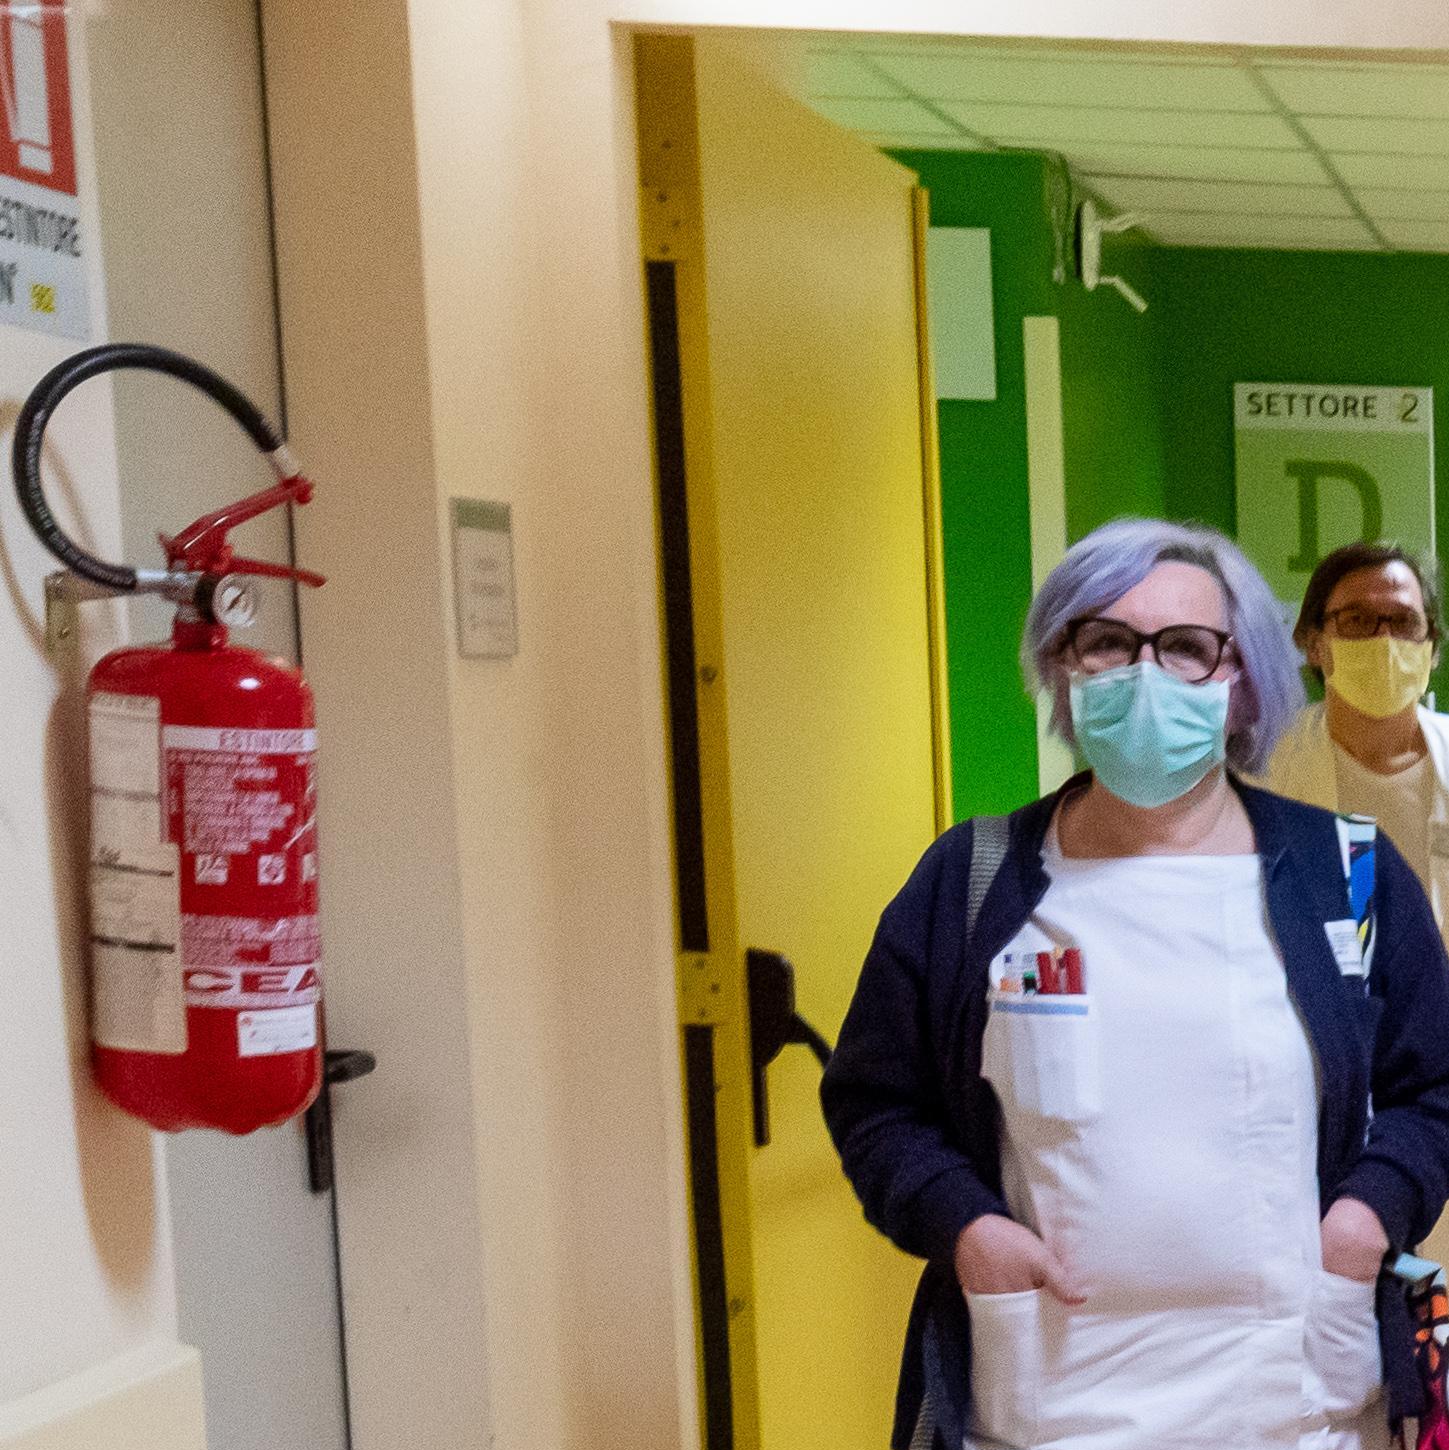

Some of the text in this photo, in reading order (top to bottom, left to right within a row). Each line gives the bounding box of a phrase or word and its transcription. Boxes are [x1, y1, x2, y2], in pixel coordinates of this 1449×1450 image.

[1246, 391, 1420, 423] SETTORE 2
[1284, 458, 1383, 574] D
